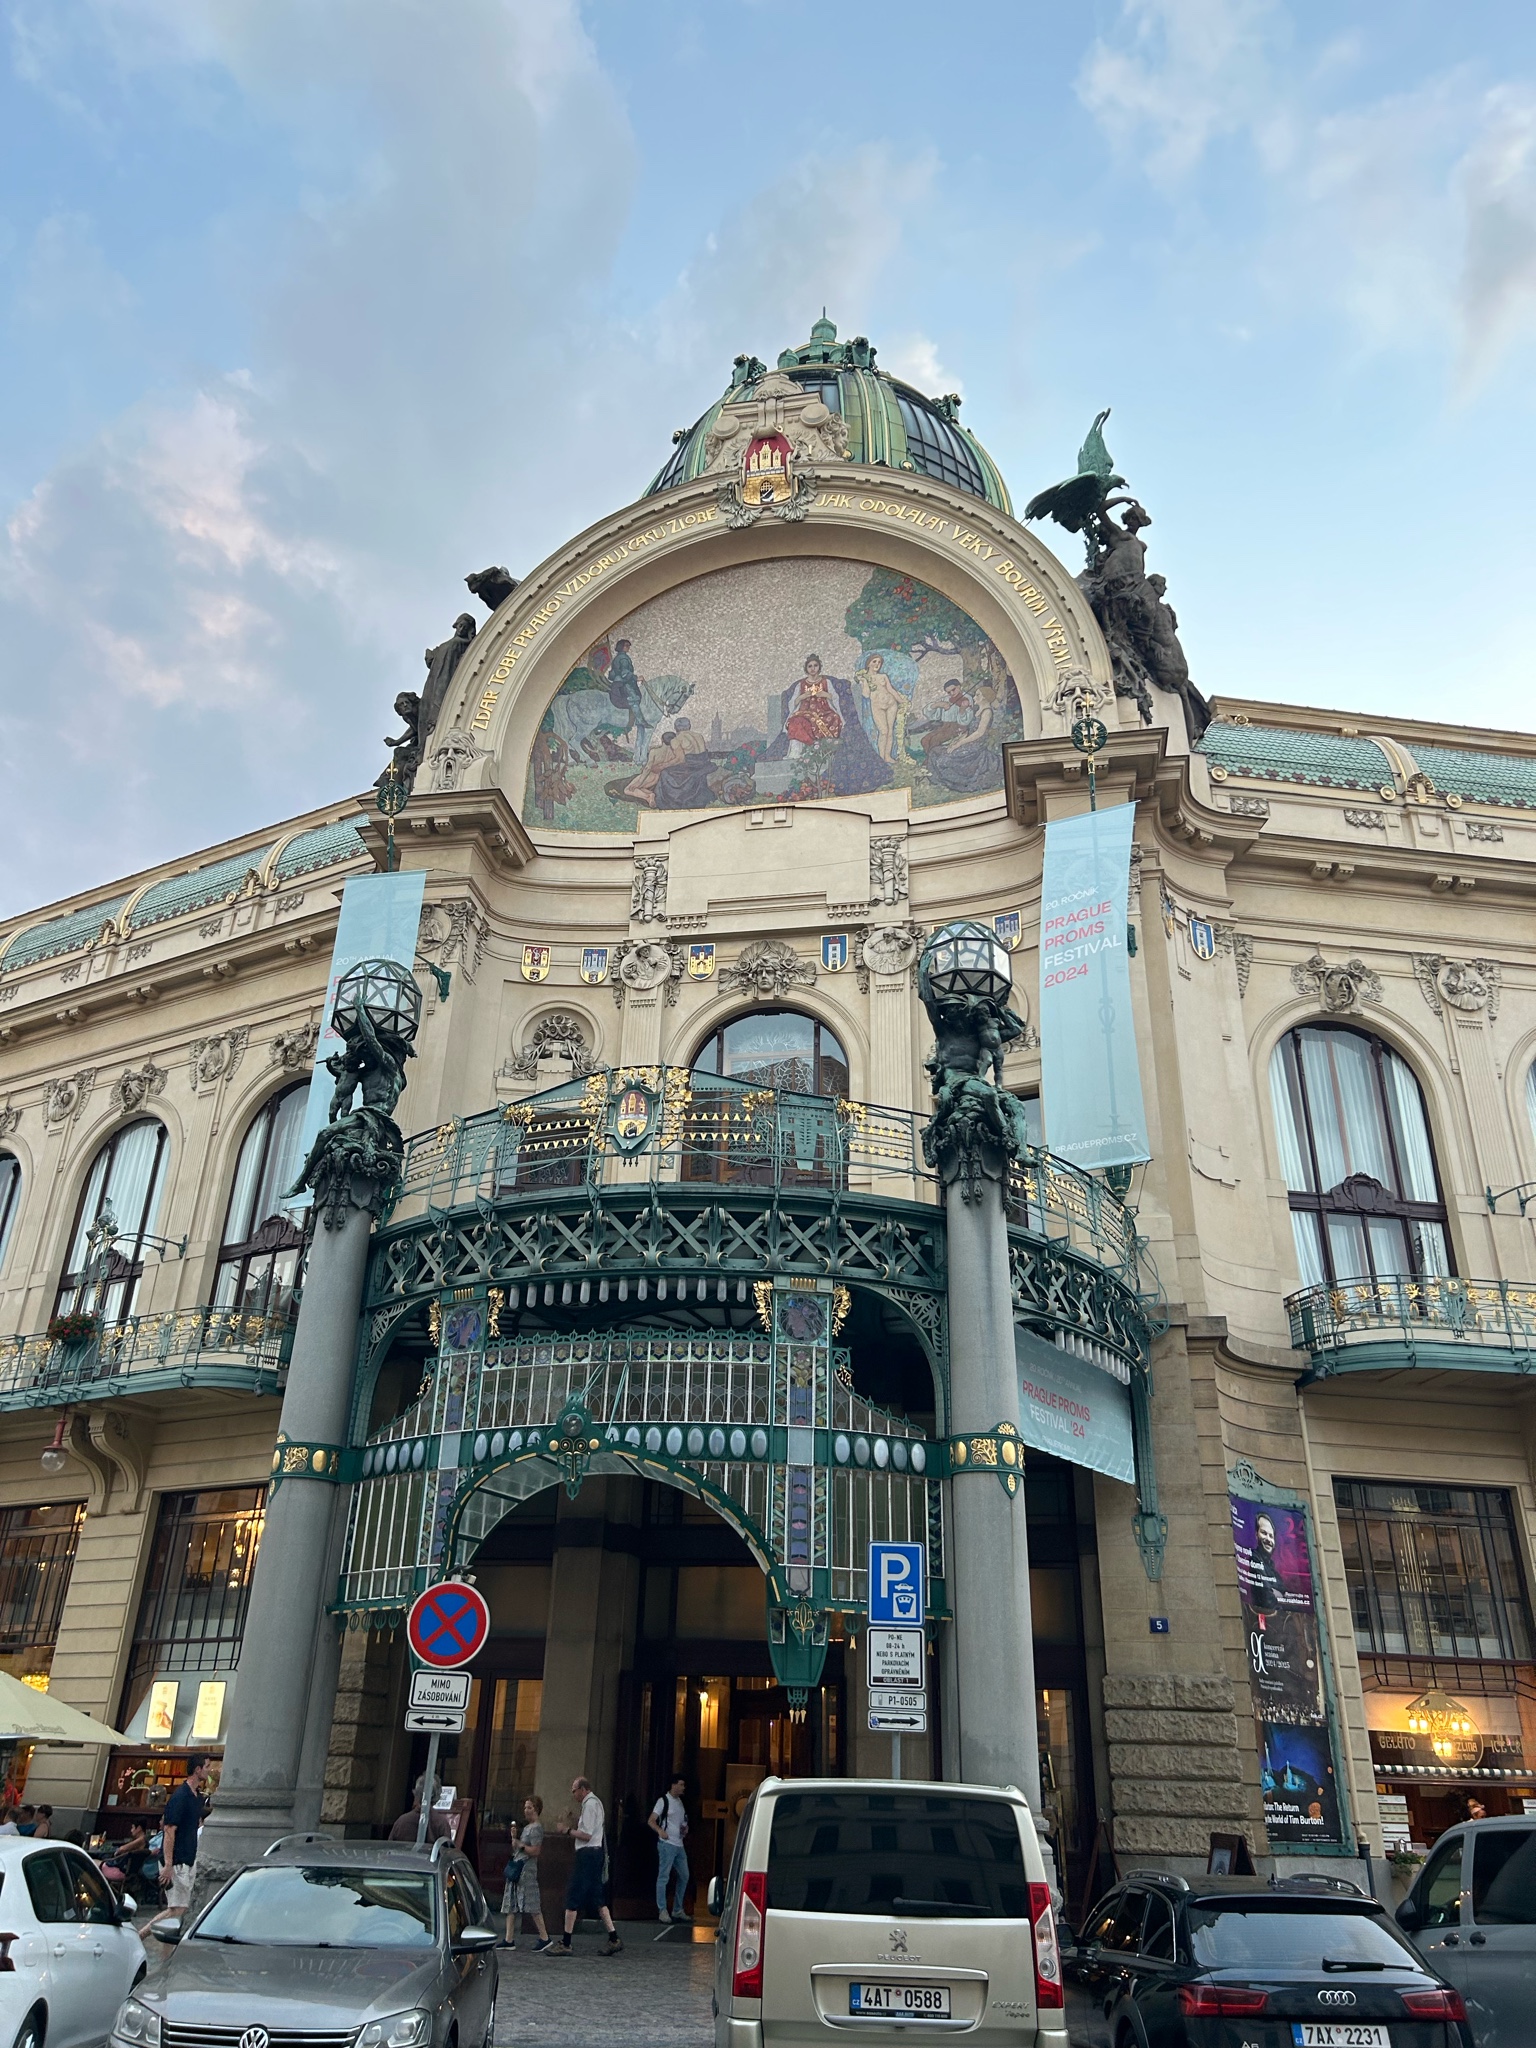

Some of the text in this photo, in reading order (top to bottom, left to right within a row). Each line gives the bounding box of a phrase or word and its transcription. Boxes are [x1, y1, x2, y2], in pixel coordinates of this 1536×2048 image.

[815, 493, 856, 509] JAK
[859, 498, 949, 534] ODOLALAS
[951, 525, 1001, 561] VĚKY
[994, 559, 1049, 618] BOUŘÍM
[470, 503, 719, 731] ZDAR TOBĚ PRAHO! VZDORUJ ČASU ZLOBĚ
[1044, 900, 1112, 933] PRAGUE
[1044, 920, 1105, 951] PROMS
[1044, 934, 1122, 970] FESTIVAL
[1044, 963, 1089, 988] 2024
[1055, 1132, 1137, 1153] PRAGUEPROMS.CZ
[1022, 1379, 1091, 1422] PRAGUE PROMS
[1029, 1403, 1085, 1439] FESTIVAL '24
[880, 1553, 911, 1598] P
[1156, 1620, 1163, 1630] 5
[881, 1659, 910, 1667] PARKOVACÍM
[894, 1650, 915, 1658] PLATNÝM
[430, 1679, 451, 1689] MIMO
[417, 1689, 462, 1703] ZÁSOBOVÁNÍ
[888, 1695, 917, 1706] P1-0505
[1273, 1801, 1283, 1811] The
[1282, 1802, 1300, 1812] Return
[1300, 1815, 1325, 1825] Burton!
[864, 1987, 942, 2010] 4AT 0588
[1304, 2026, 1383, 2046] 7AX 2231
